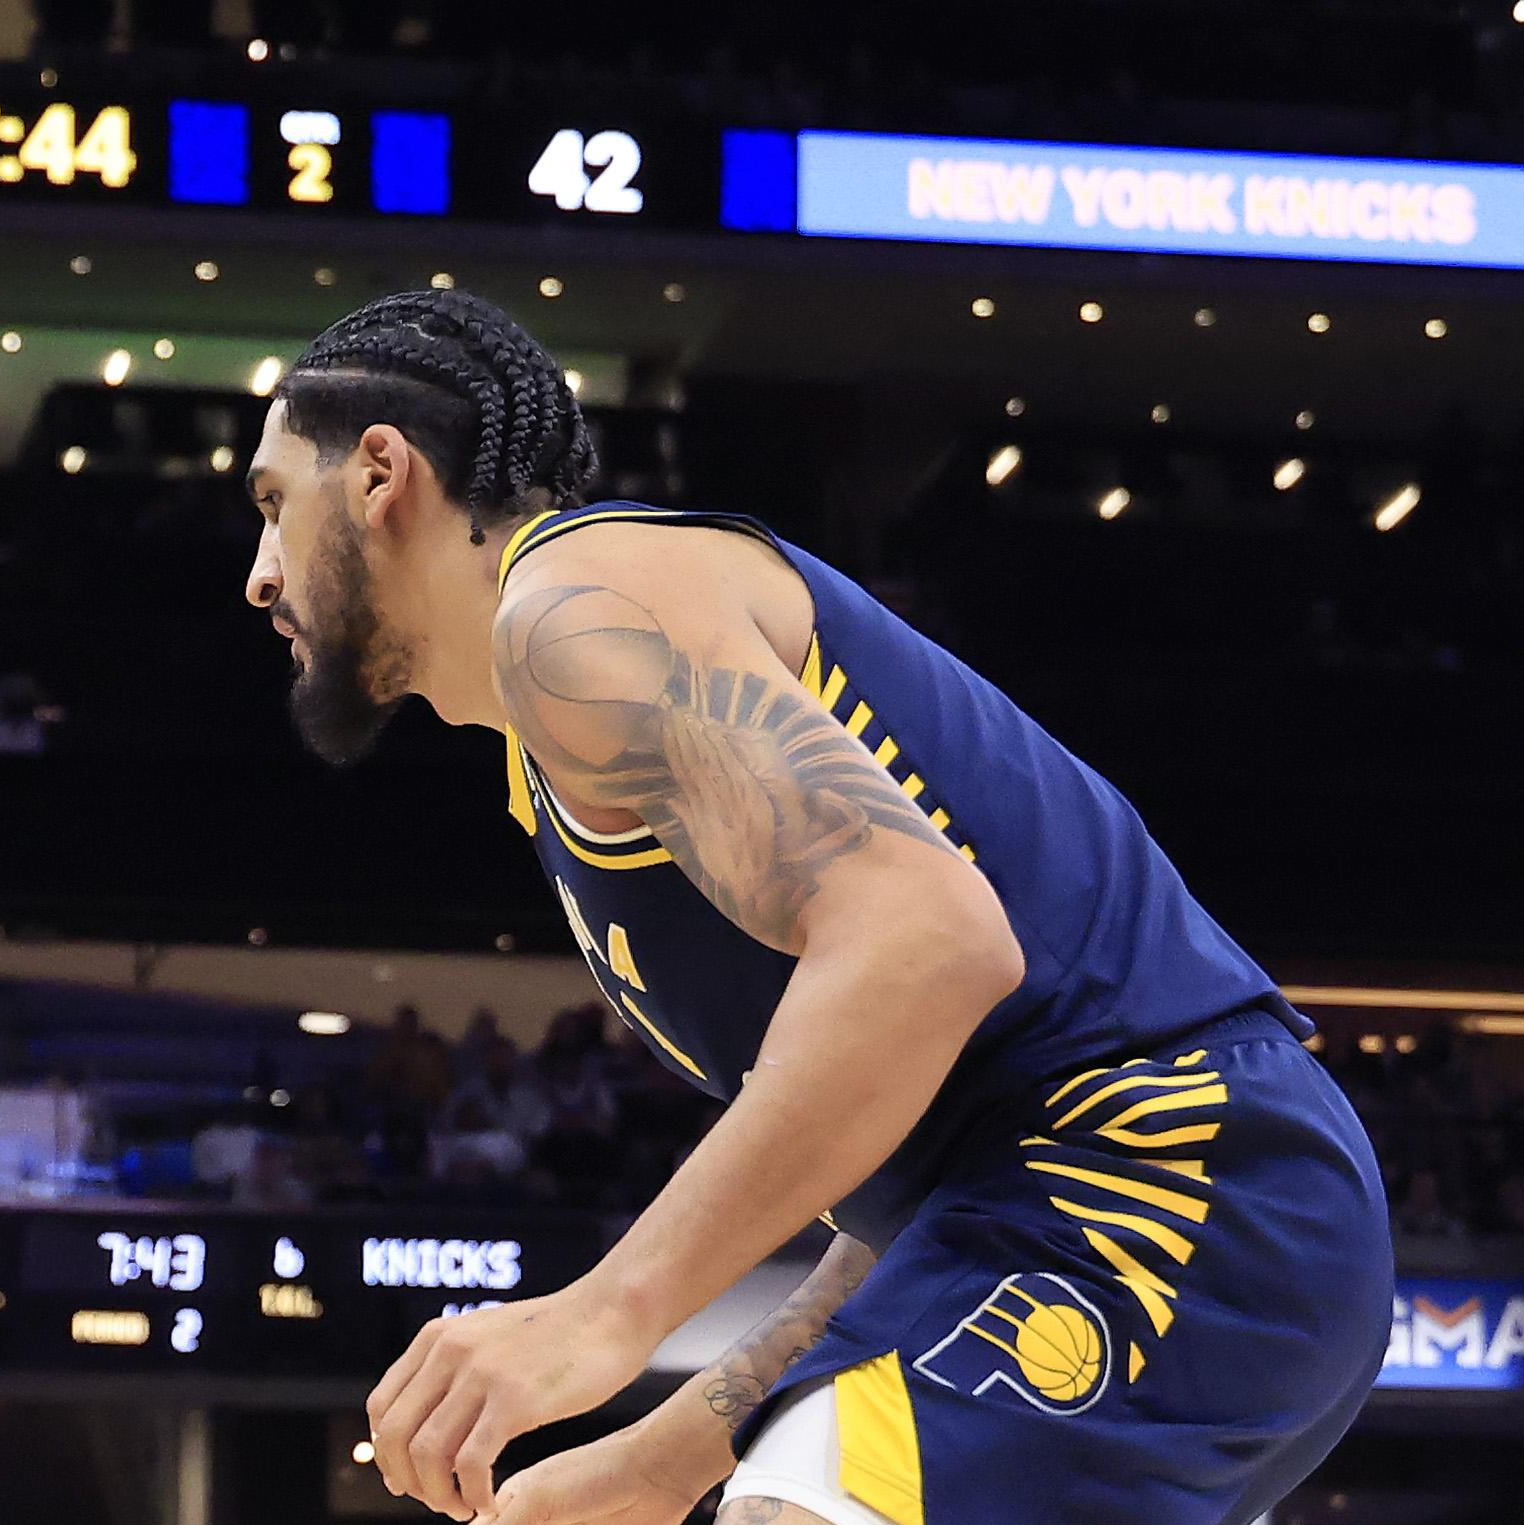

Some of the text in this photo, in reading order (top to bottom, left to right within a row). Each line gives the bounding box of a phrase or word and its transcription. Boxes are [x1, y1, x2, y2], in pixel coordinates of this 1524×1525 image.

[288, 143, 334, 202] 2
[528, 129, 643, 213] 42
[907, 157, 1479, 246] NEW YORK KNICKS
[97, 1232, 206, 1291] 7:43
[362, 1237, 522, 1290] KNICKS
